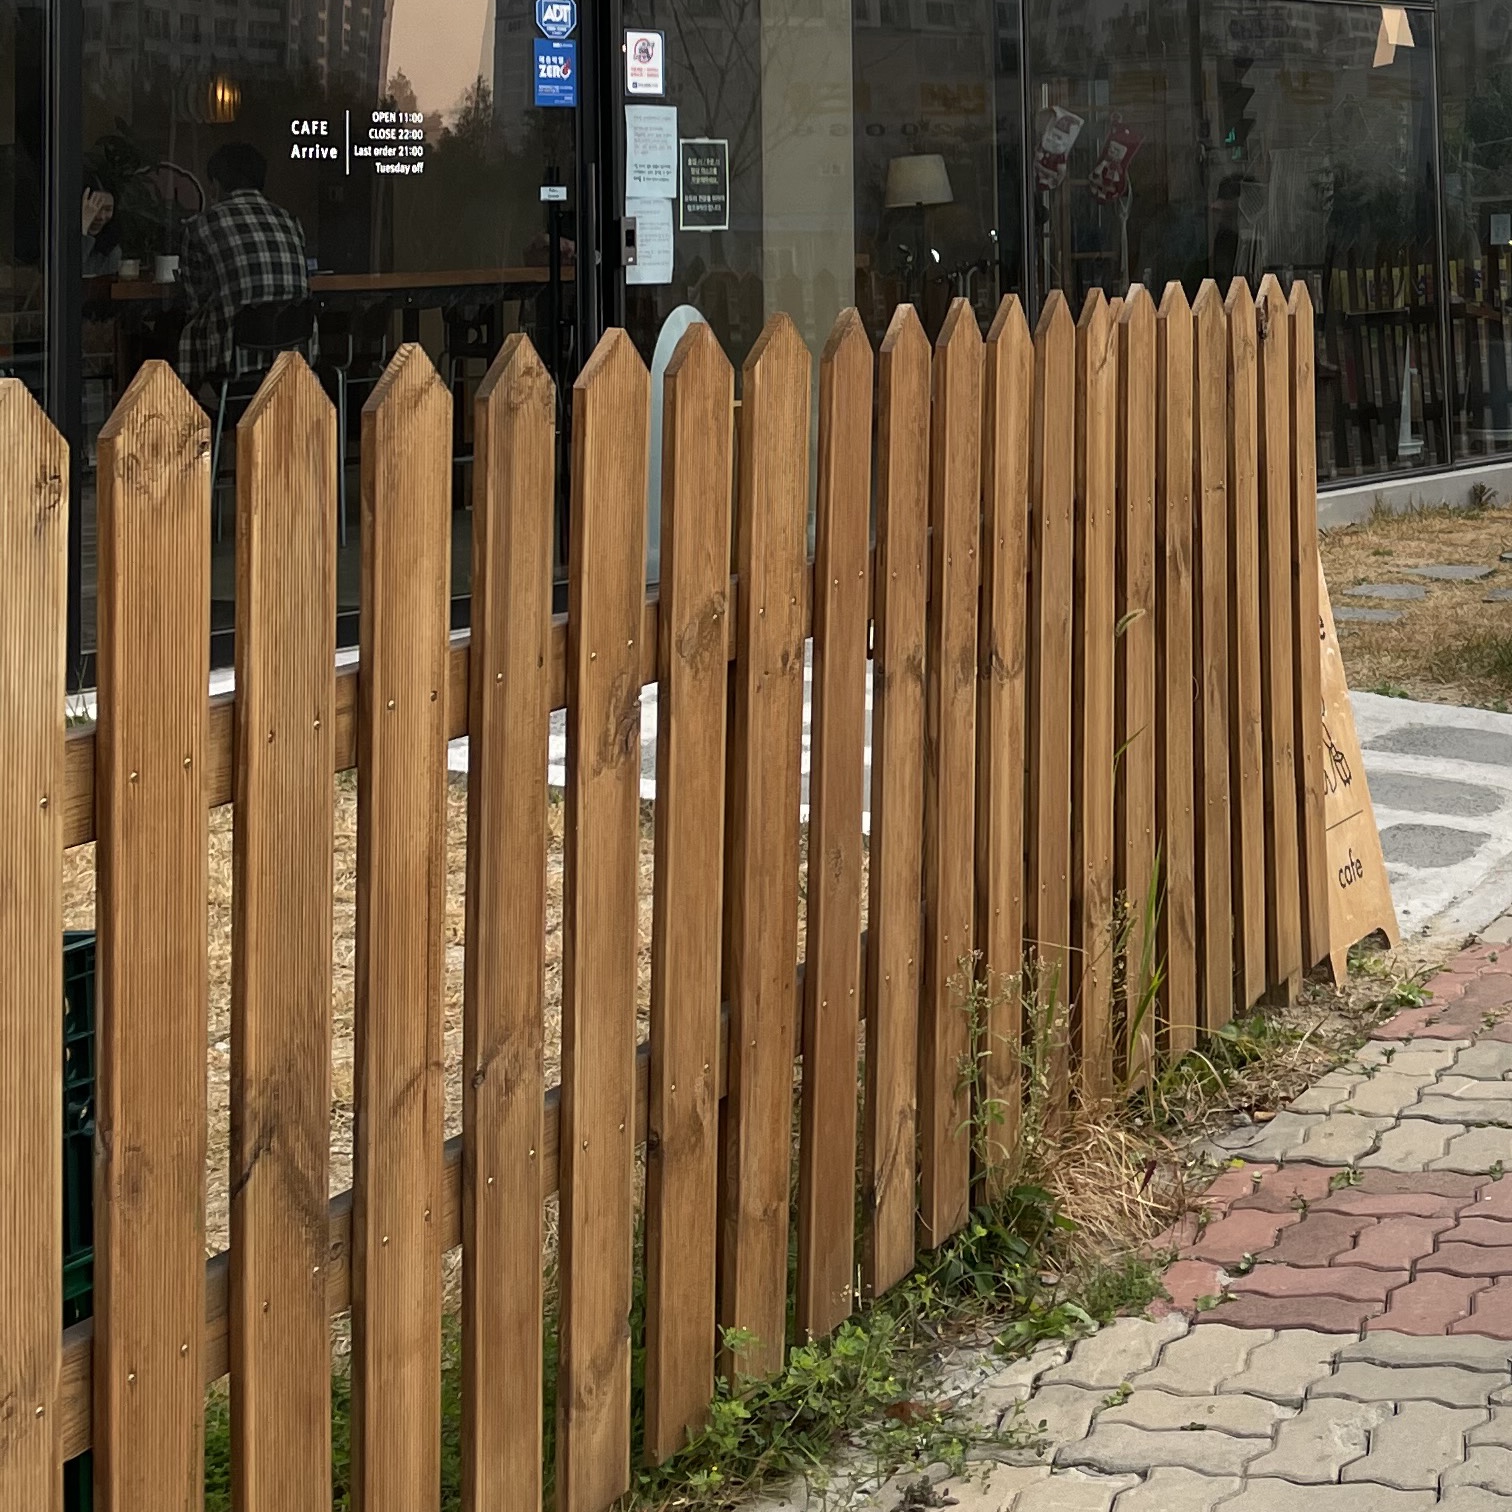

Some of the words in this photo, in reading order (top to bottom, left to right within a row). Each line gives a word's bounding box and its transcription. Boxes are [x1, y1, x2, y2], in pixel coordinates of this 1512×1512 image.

[542, 3, 571, 23] ADT
[372, 111, 396, 123] OPEN
[398, 112, 424, 124] 11:00
[291, 120, 328, 135] CAFE
[368, 128, 397, 140] CLOSE
[398, 128, 424, 140] 22:00
[290, 144, 338, 159] Arrive
[354, 144, 372, 157] Last
[373, 145, 397, 157] order
[398, 145, 424, 157] 21:00
[375, 161, 411, 175] Tuesday
[411, 161, 424, 174] off
[1338, 847, 1363, 889] cafe
